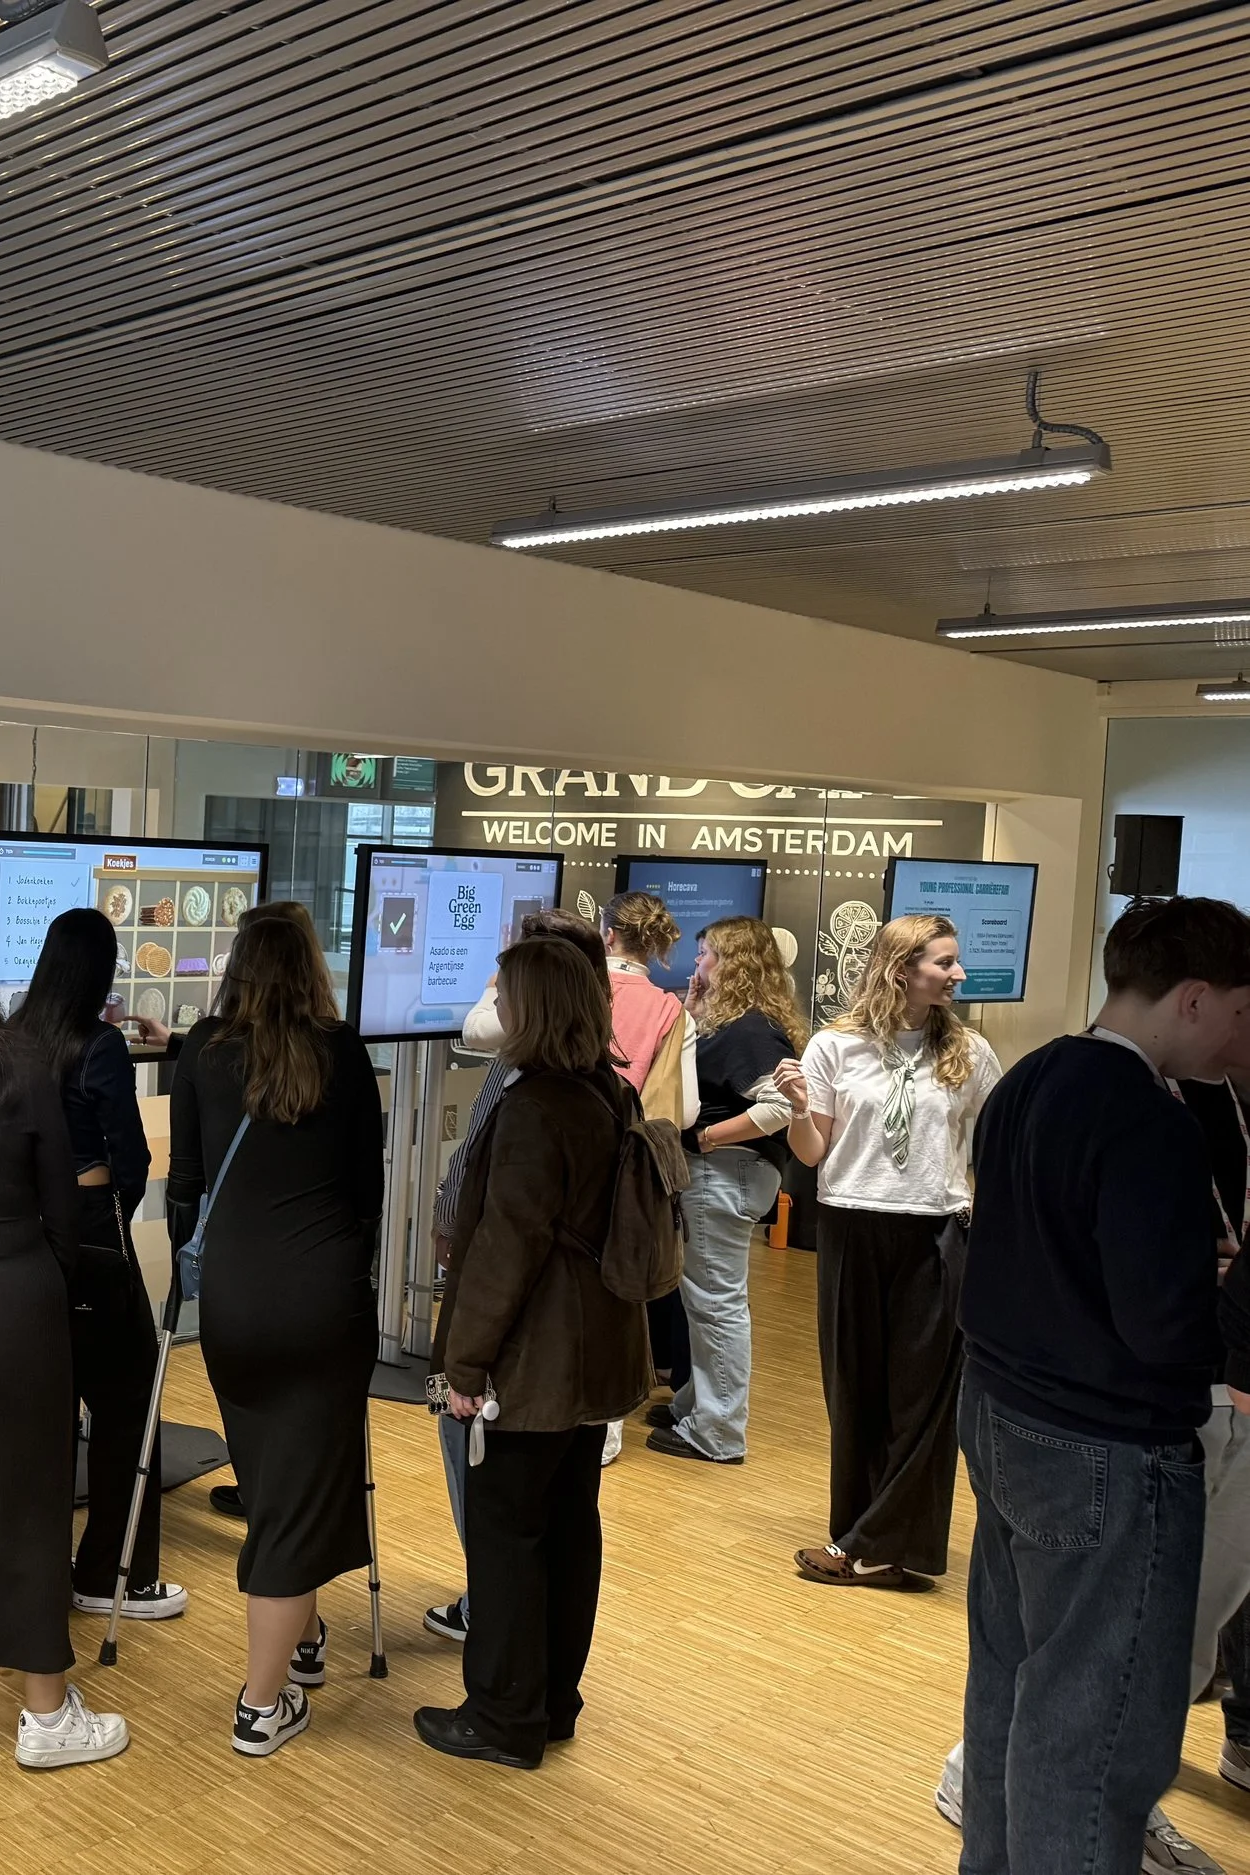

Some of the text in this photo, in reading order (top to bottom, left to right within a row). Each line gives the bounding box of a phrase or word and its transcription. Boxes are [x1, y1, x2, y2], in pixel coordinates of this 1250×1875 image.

[483, 821, 913, 858] WELCOME IN AMSTERDAM
[107, 858, 134, 869] Koekjes
[457, 885, 476, 902] Big
[449, 899, 481, 914] Green
[454, 914, 477, 930] Egg
[430, 946, 449, 955] Asado
[429, 961, 464, 973] Argentijnse
[428, 976, 457, 986] barbecue
[300, 1647, 315, 1655] NIKE
[238, 1710, 252, 1720] NIKE
